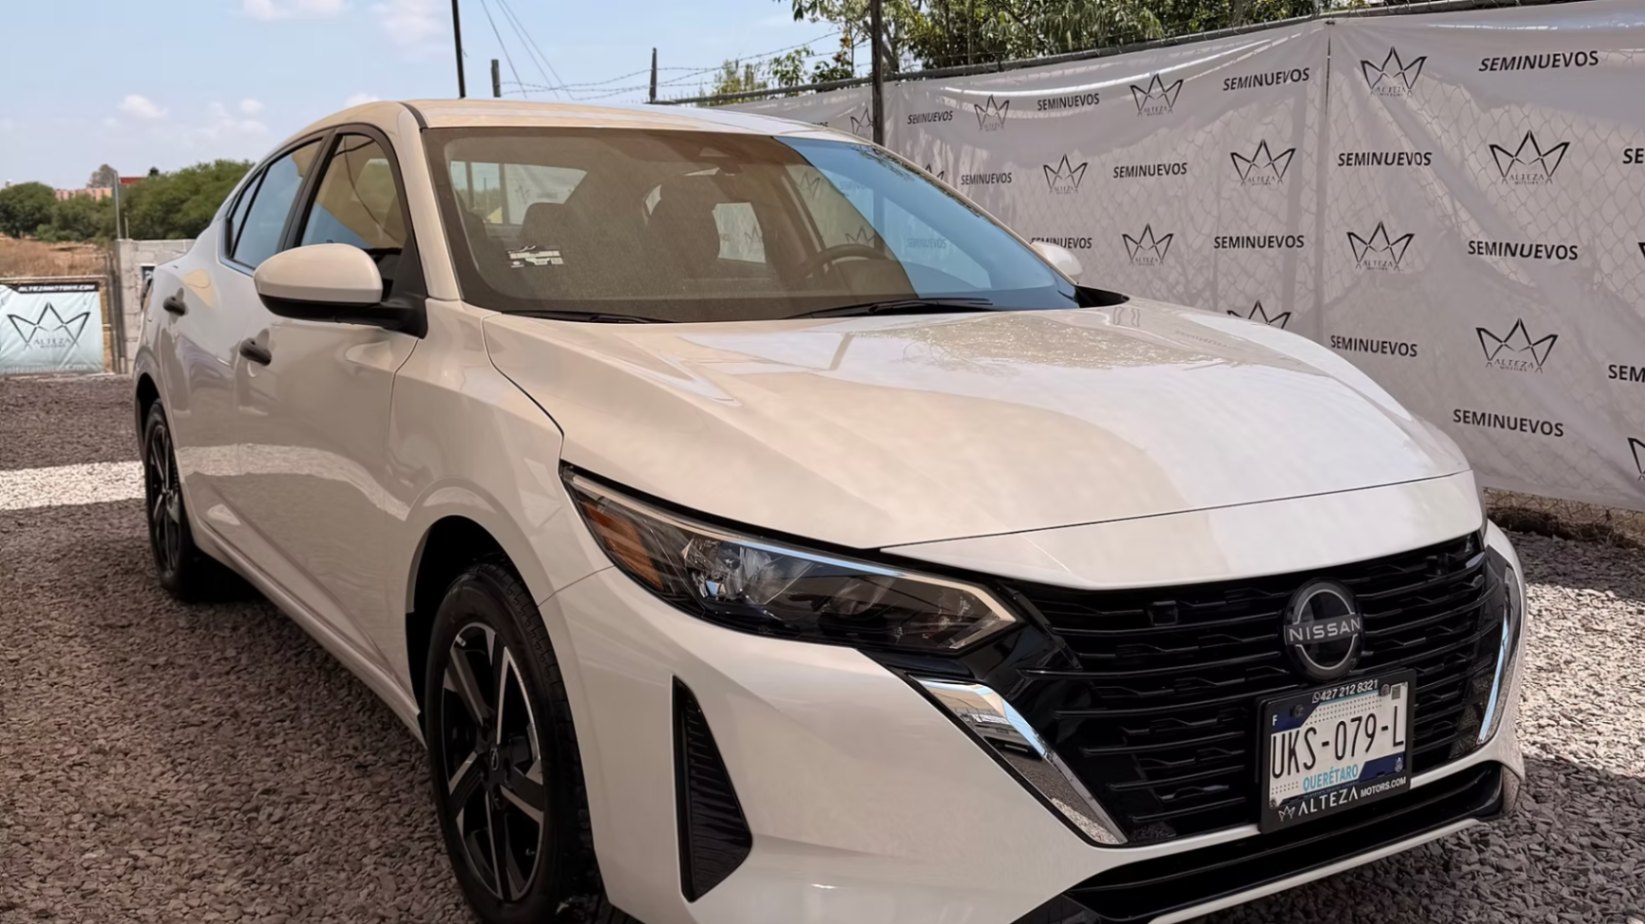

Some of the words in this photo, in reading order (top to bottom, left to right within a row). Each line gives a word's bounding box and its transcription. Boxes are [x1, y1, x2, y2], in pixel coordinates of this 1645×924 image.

[1479, 50, 1599, 72] SEMINUEVOS
[1223, 67, 1310, 91] SEMINUEVOS
[1037, 93, 1100, 111] SEMINUEVOS
[906, 110, 953, 125] SEMINUEVOS
[1338, 151, 1432, 167] SEMINUEVOS
[1622, 148, 1644, 164] SE
[961, 172, 1012, 186] SEMINUEVOS
[1113, 162, 1188, 179] SEMINUEVOS
[1214, 235, 1304, 249] SEMINUEVOS
[1468, 240, 1578, 261] SEMINUEVOS
[1330, 335, 1418, 357] SEMINUEVOS
[1608, 364, 1645, 383] SEM
[1453, 409, 1564, 438] SEMINUEVOS
[1289, 618, 1361, 642] NISSAN
[1320, 688, 1337, 701] 427
[1340, 684, 1355, 697] 212
[1357, 680, 1378, 692] 8321
[1272, 715, 1278, 726] F
[1272, 706, 1404, 779] UKS-079-L
[1303, 764, 1359, 791] QUERÉTARO
[1298, 786, 1358, 816] ALTEZA
[1360, 777, 1406, 797] MOTORS.COM
